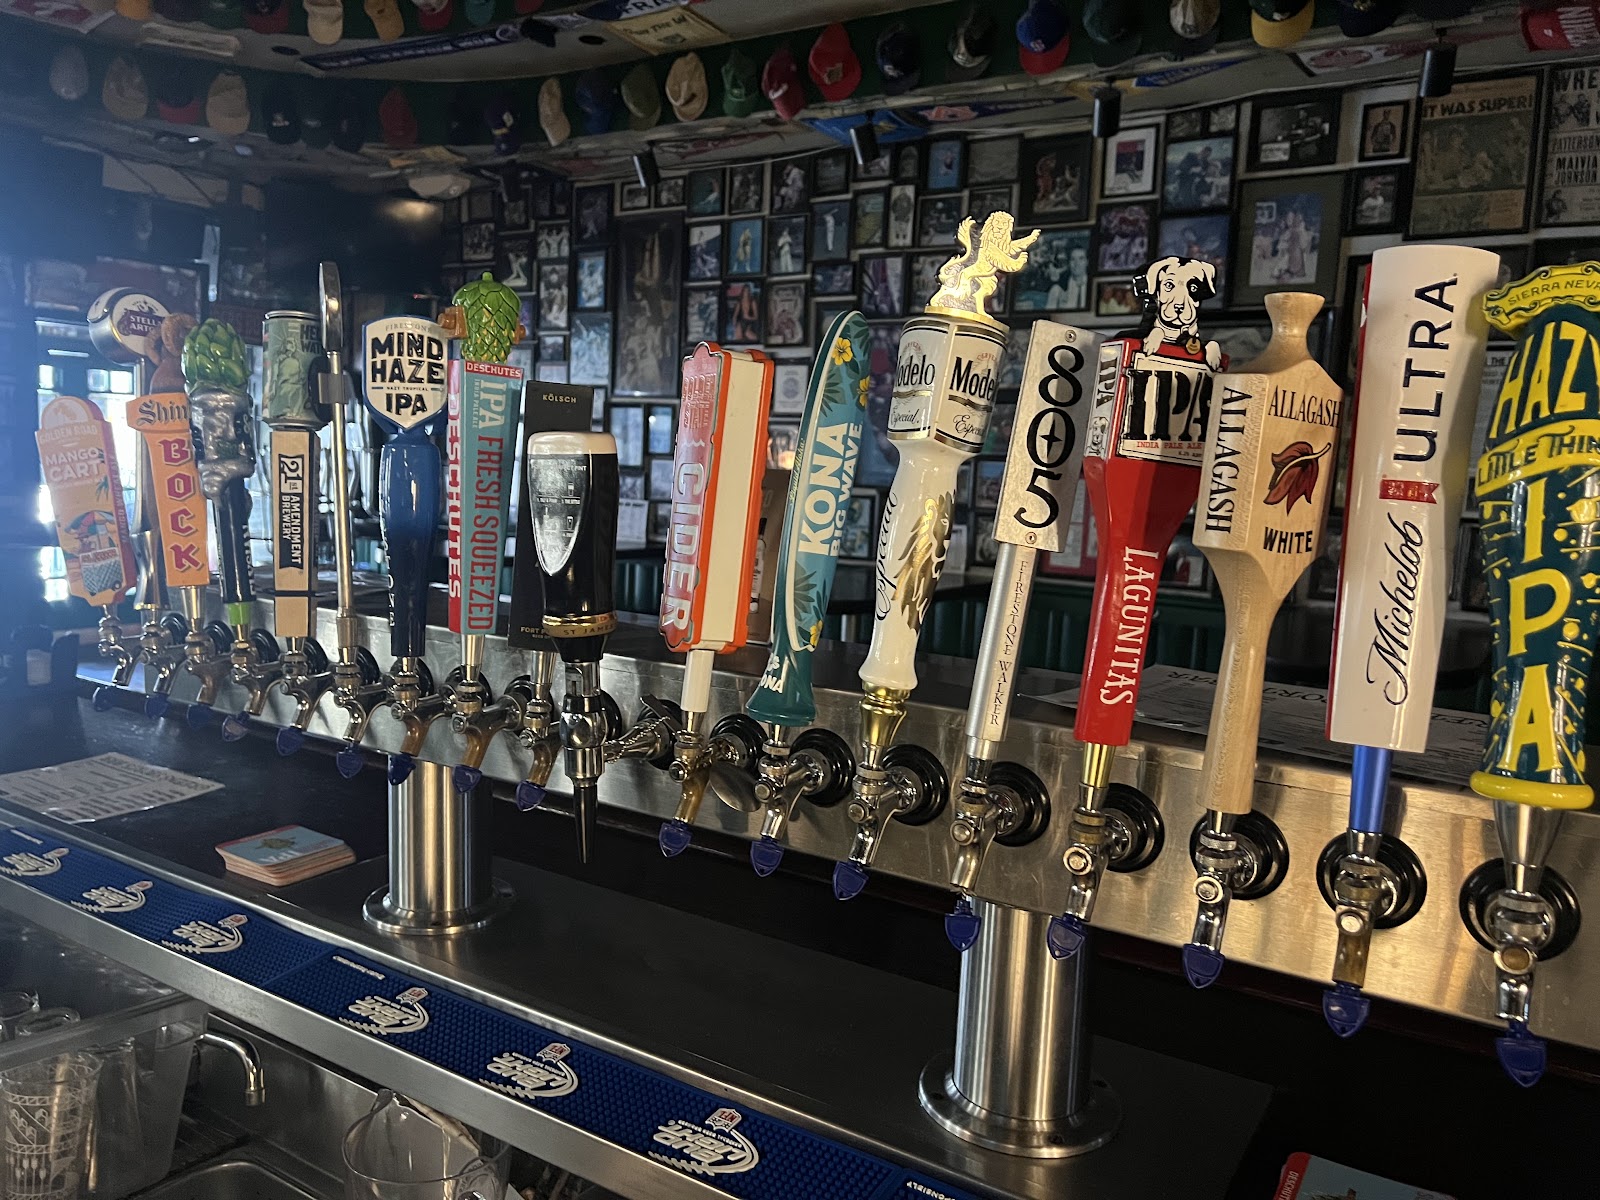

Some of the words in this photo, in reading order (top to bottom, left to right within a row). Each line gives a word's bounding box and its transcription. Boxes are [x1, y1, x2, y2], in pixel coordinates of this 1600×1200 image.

[1440, 101, 1476, 115] WAS
[1508, 281, 1561, 305] SIERRA
[129, 322, 155, 333] ARTO
[371, 331, 443, 361] MIND
[371, 358, 445, 384] HAZE
[466, 362, 523, 378] DESCHUTES
[949, 356, 998, 401] Mode
[1096, 357, 1117, 408] IPA
[1394, 276, 1457, 465] ULTRA
[136, 399, 190, 425] Shin
[385, 392, 428, 416] IPA
[479, 379, 507, 429] IPA
[542, 393, 577, 404] KÖLSCH
[1121, 369, 1213, 442] IPA
[1268, 385, 1343, 429] ALLAGASH
[39, 430, 72, 445] GOLDEN
[45, 447, 99, 466] MANGO
[1014, 344, 1084, 529] 805
[1136, 441, 1159, 449] INDIA
[1478, 441, 1538, 487] LITTLE
[1539, 424, 1600, 459] THIN
[49, 460, 103, 483] CART
[474, 434, 505, 511] FRESH
[1205, 386, 1253, 534] ALLAGASH
[159, 439, 203, 572] BOCK
[448, 392, 461, 599] DESCHUTES
[798, 422, 847, 557] KONA
[829, 509, 846, 557] BIG
[838, 422, 863, 503] WAVE
[281, 494, 292, 540] BREWERY
[290, 494, 302, 564] AMENDMENT
[660, 461, 704, 632] CIDER
[1263, 527, 1313, 554] WHITE
[467, 514, 499, 631] SQUEEZED
[563, 628, 576, 636] ST
[584, 623, 614, 635] JAMES
[1003, 560, 1029, 656] FIRESTONE
[1099, 545, 1159, 706] LAGUNITAS
[1366, 512, 1424, 706] Michelob
[1496, 474, 1573, 772] IPA
[520, 626, 540, 635] FORT
[760, 673, 783, 694] ONA
[990, 659, 1013, 726] WALKER
[719, 1110, 738, 1123] NFL
[653, 1131, 724, 1163] BUD
[658, 1124, 747, 1161] LIGHT
[1279, 1171, 1299, 1200] DESCHUT
